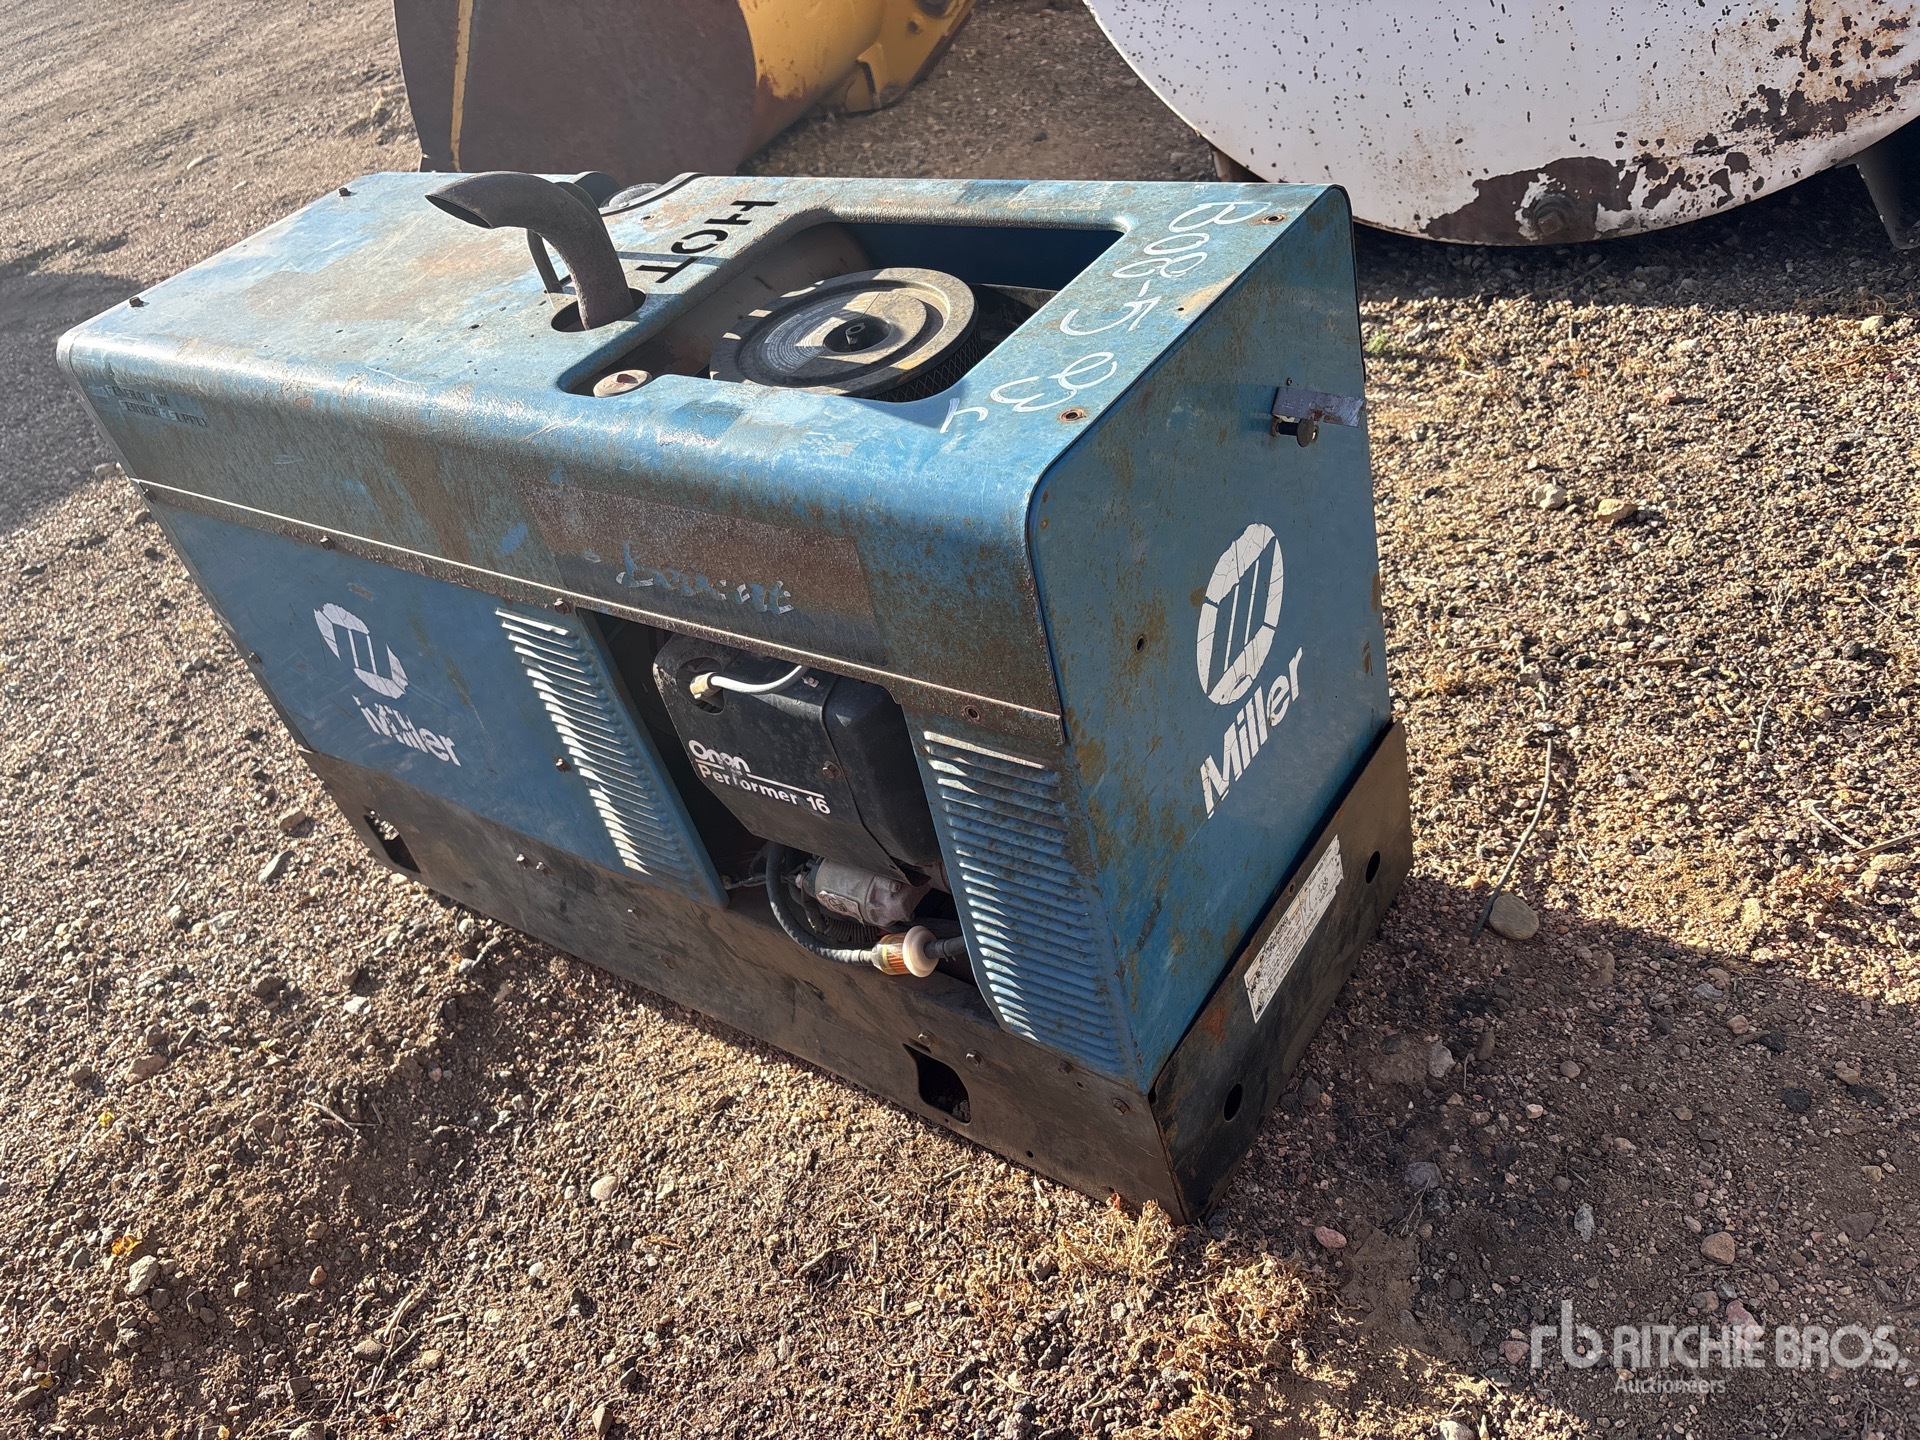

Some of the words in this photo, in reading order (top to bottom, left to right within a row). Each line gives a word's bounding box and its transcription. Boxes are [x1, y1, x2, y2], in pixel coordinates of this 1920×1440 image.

[635, 200, 778, 283] HOT
[688, 740, 751, 773] Onan
[1200, 647, 1303, 819] Miller
[698, 763, 798, 805] Performer
[806, 795, 831, 814] 16
